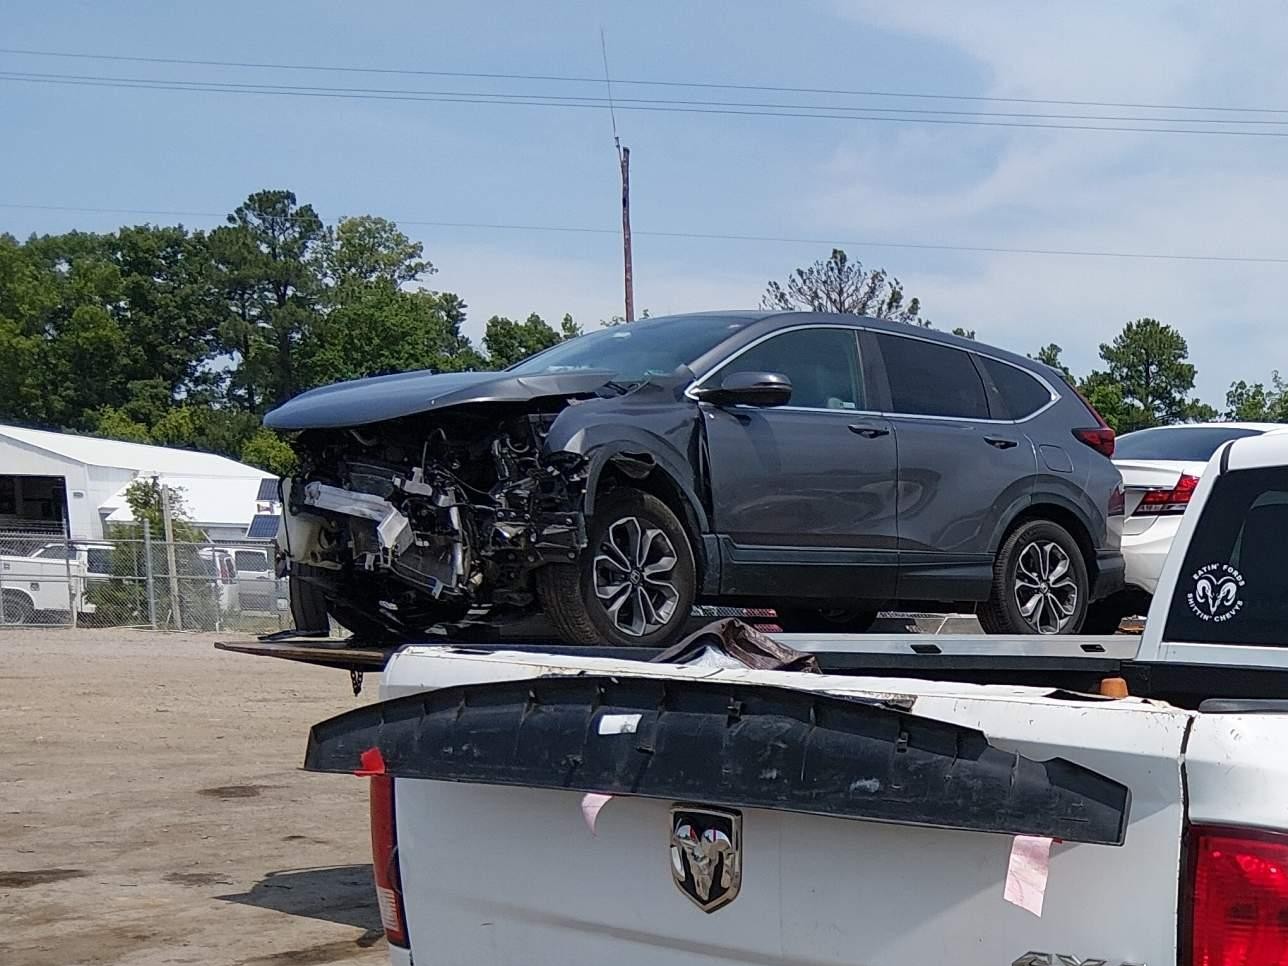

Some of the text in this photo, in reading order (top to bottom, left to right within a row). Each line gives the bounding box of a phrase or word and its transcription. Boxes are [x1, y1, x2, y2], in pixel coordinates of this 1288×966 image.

[1192, 563, 1246, 586] EATIN' FORDS
[1214, 600, 1243, 622] CHEVYS
